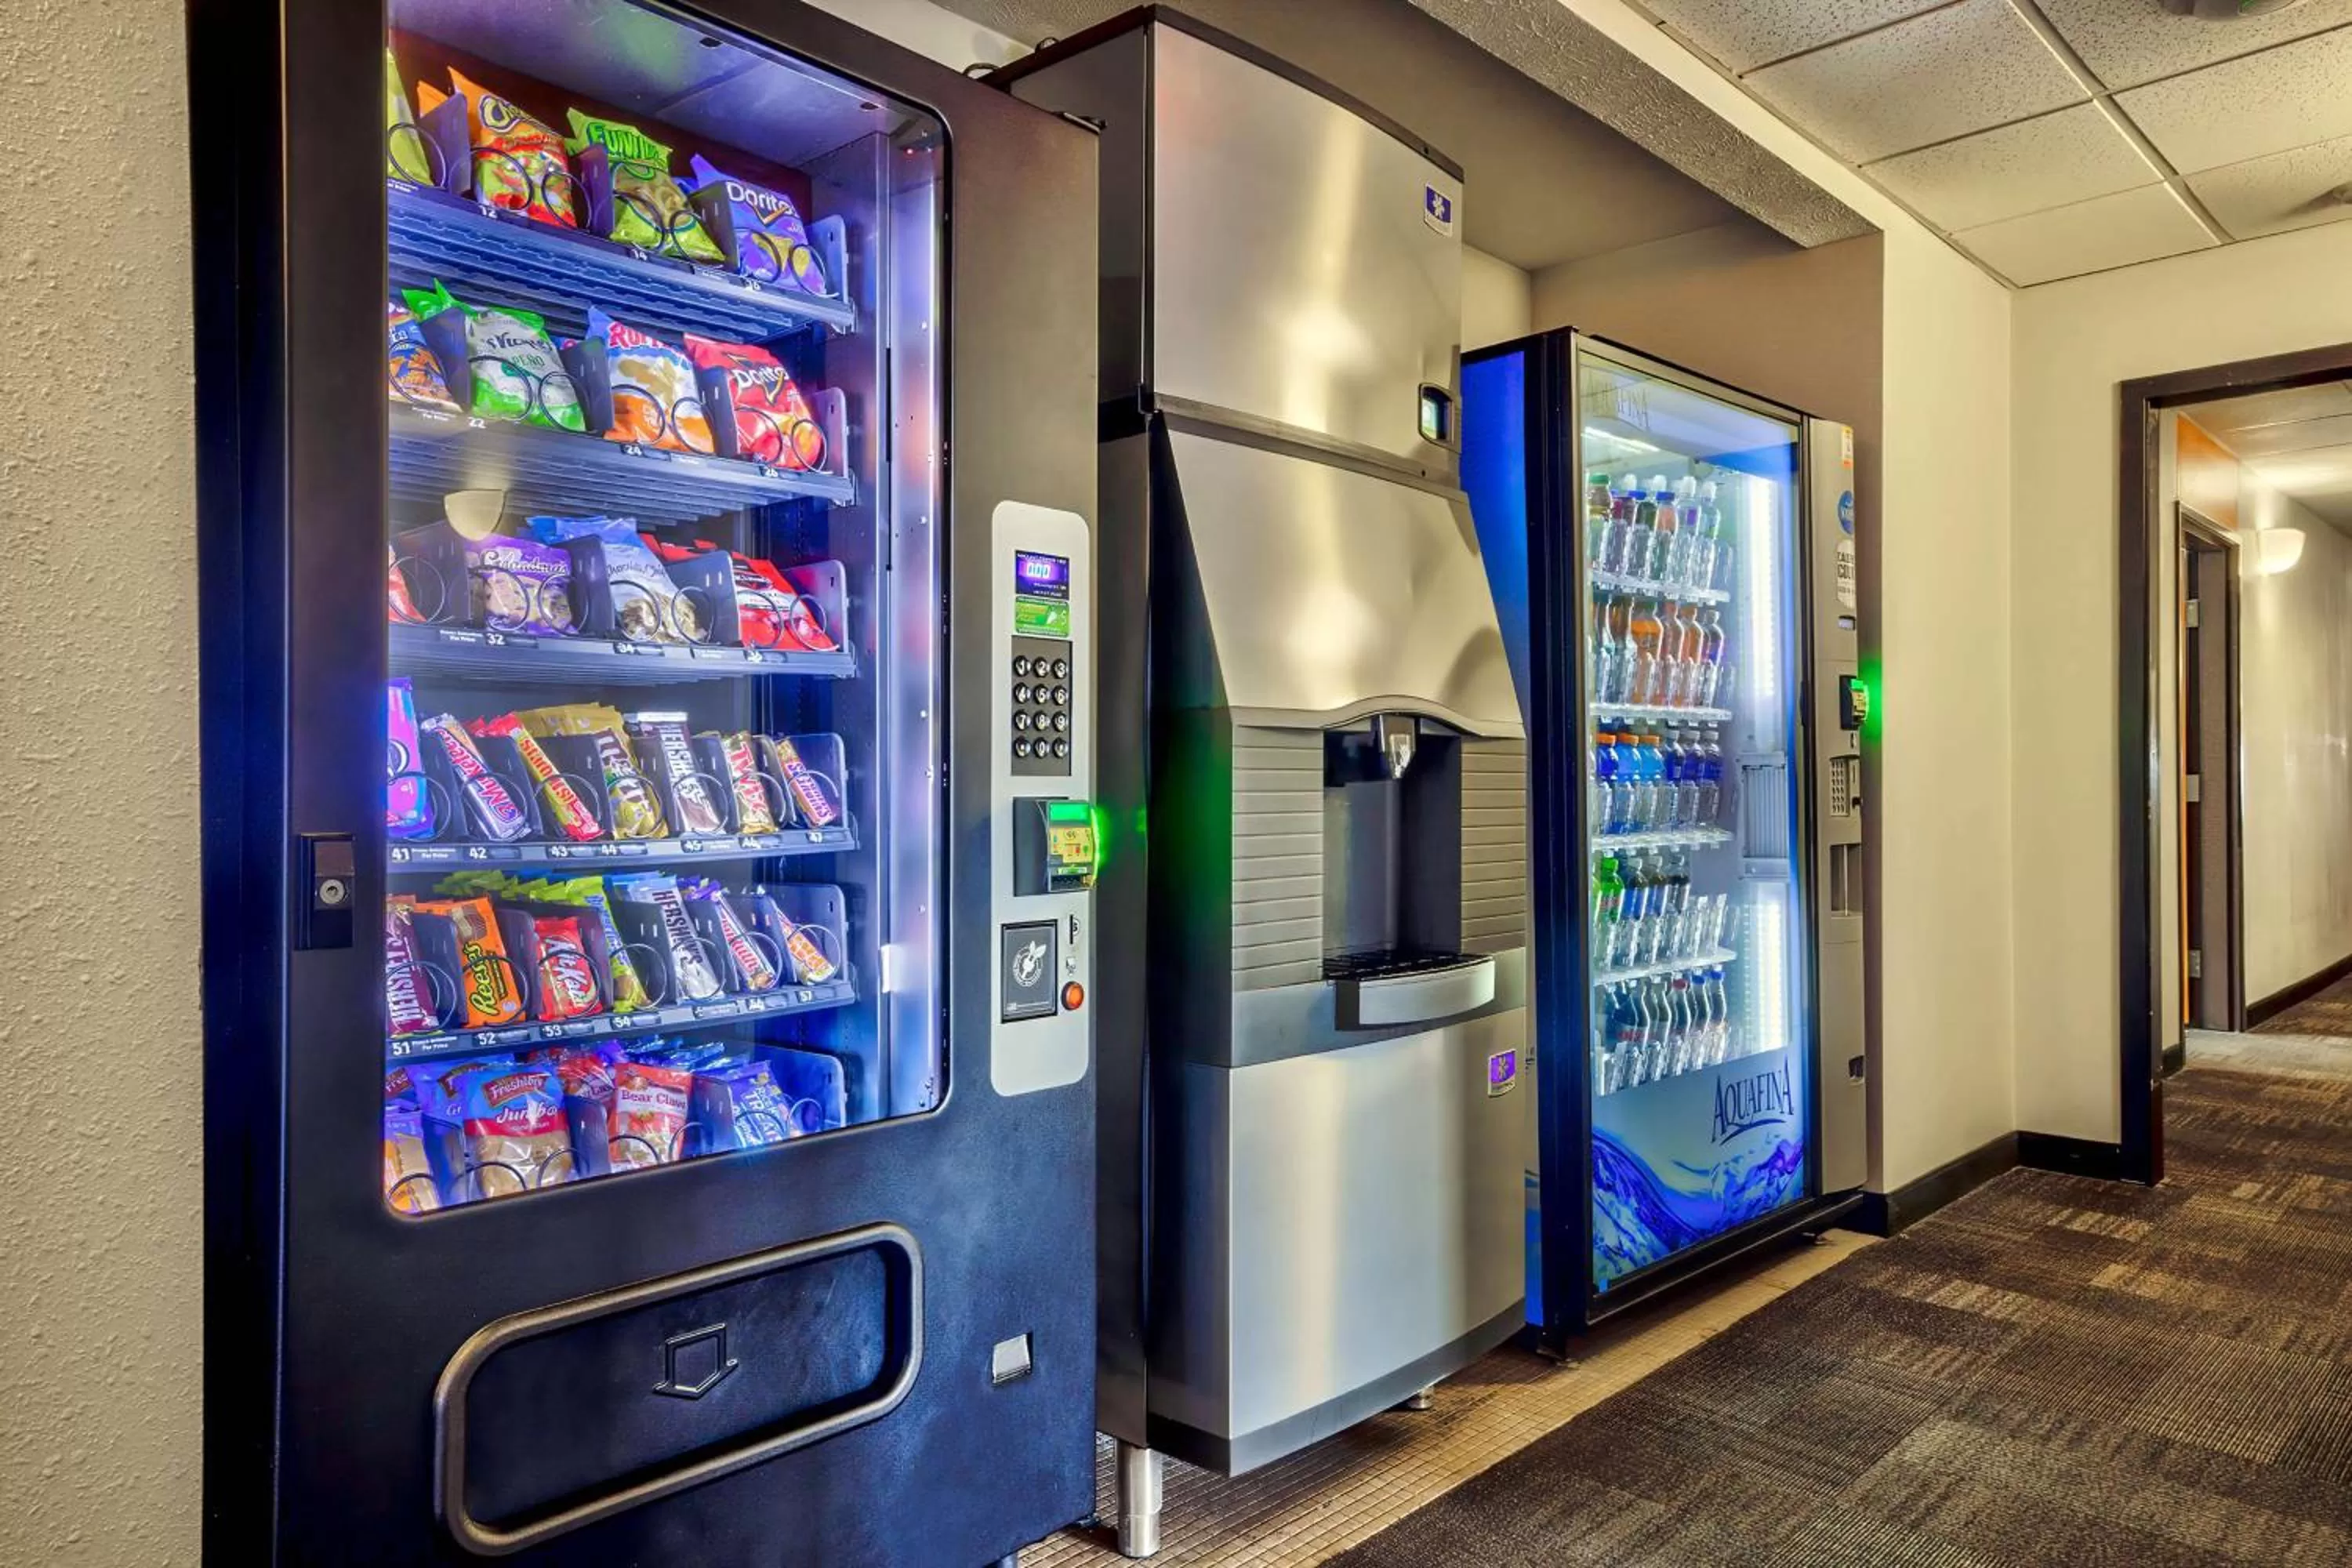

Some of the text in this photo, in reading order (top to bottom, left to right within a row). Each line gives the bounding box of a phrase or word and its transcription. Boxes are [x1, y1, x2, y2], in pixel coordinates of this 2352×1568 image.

[726, 180, 800, 219] Doritos
[479, 205, 498, 218] 12
[633, 250, 648, 261] 14
[730, 365, 789, 390] Doritos
[486, 633, 506, 645] 32
[392, 848, 410, 861] 41
[470, 847, 488, 859] 42
[551, 846, 568, 857] 43
[601, 845, 619, 856] 44
[462, 943, 501, 1014] Reese's
[615, 1016, 631, 1028] 54
[546, 1025, 562, 1038] 53
[477, 1032, 495, 1046] 52
[392, 1040, 411, 1056] 51
[621, 1089, 653, 1104] Bear
[1711, 1054, 1795, 1144] AQUAFINA
